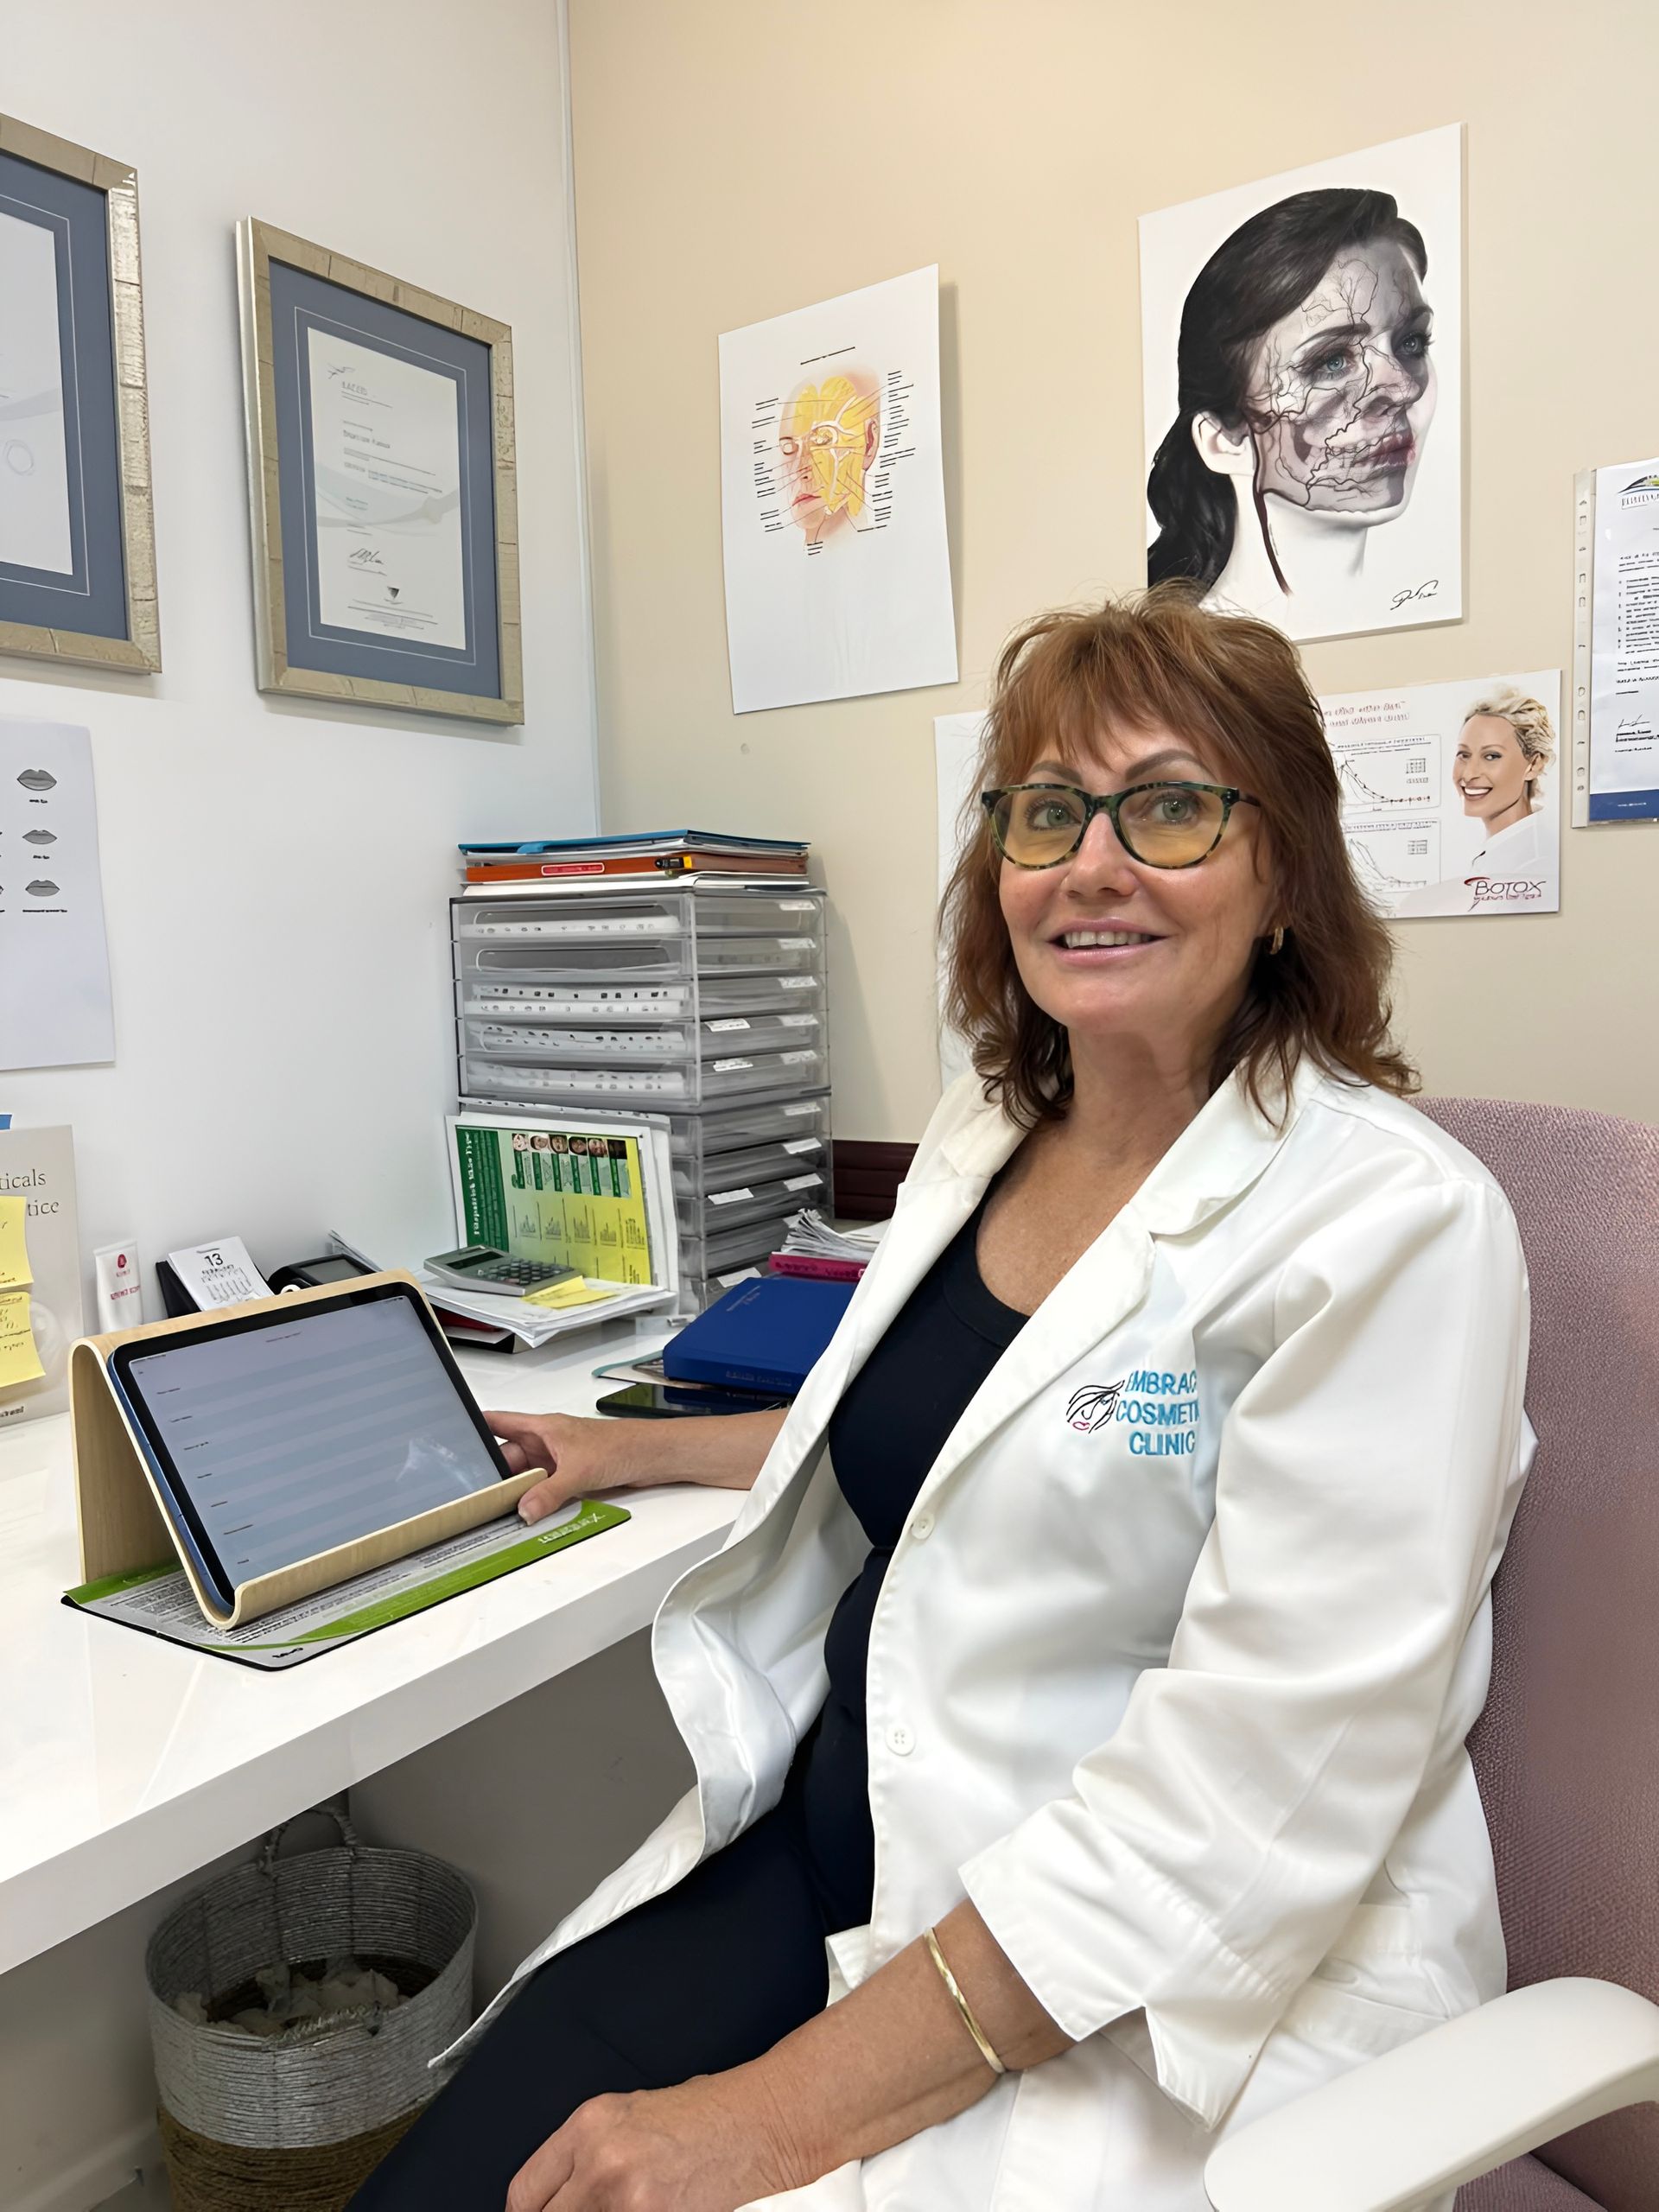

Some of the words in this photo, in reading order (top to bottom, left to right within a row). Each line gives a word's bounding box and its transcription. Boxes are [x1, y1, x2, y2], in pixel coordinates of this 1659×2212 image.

[1475, 880, 1547, 899] BOTOX
[204, 1253, 223, 1267] 13
[1129, 1430, 1195, 1456] CLINIC
